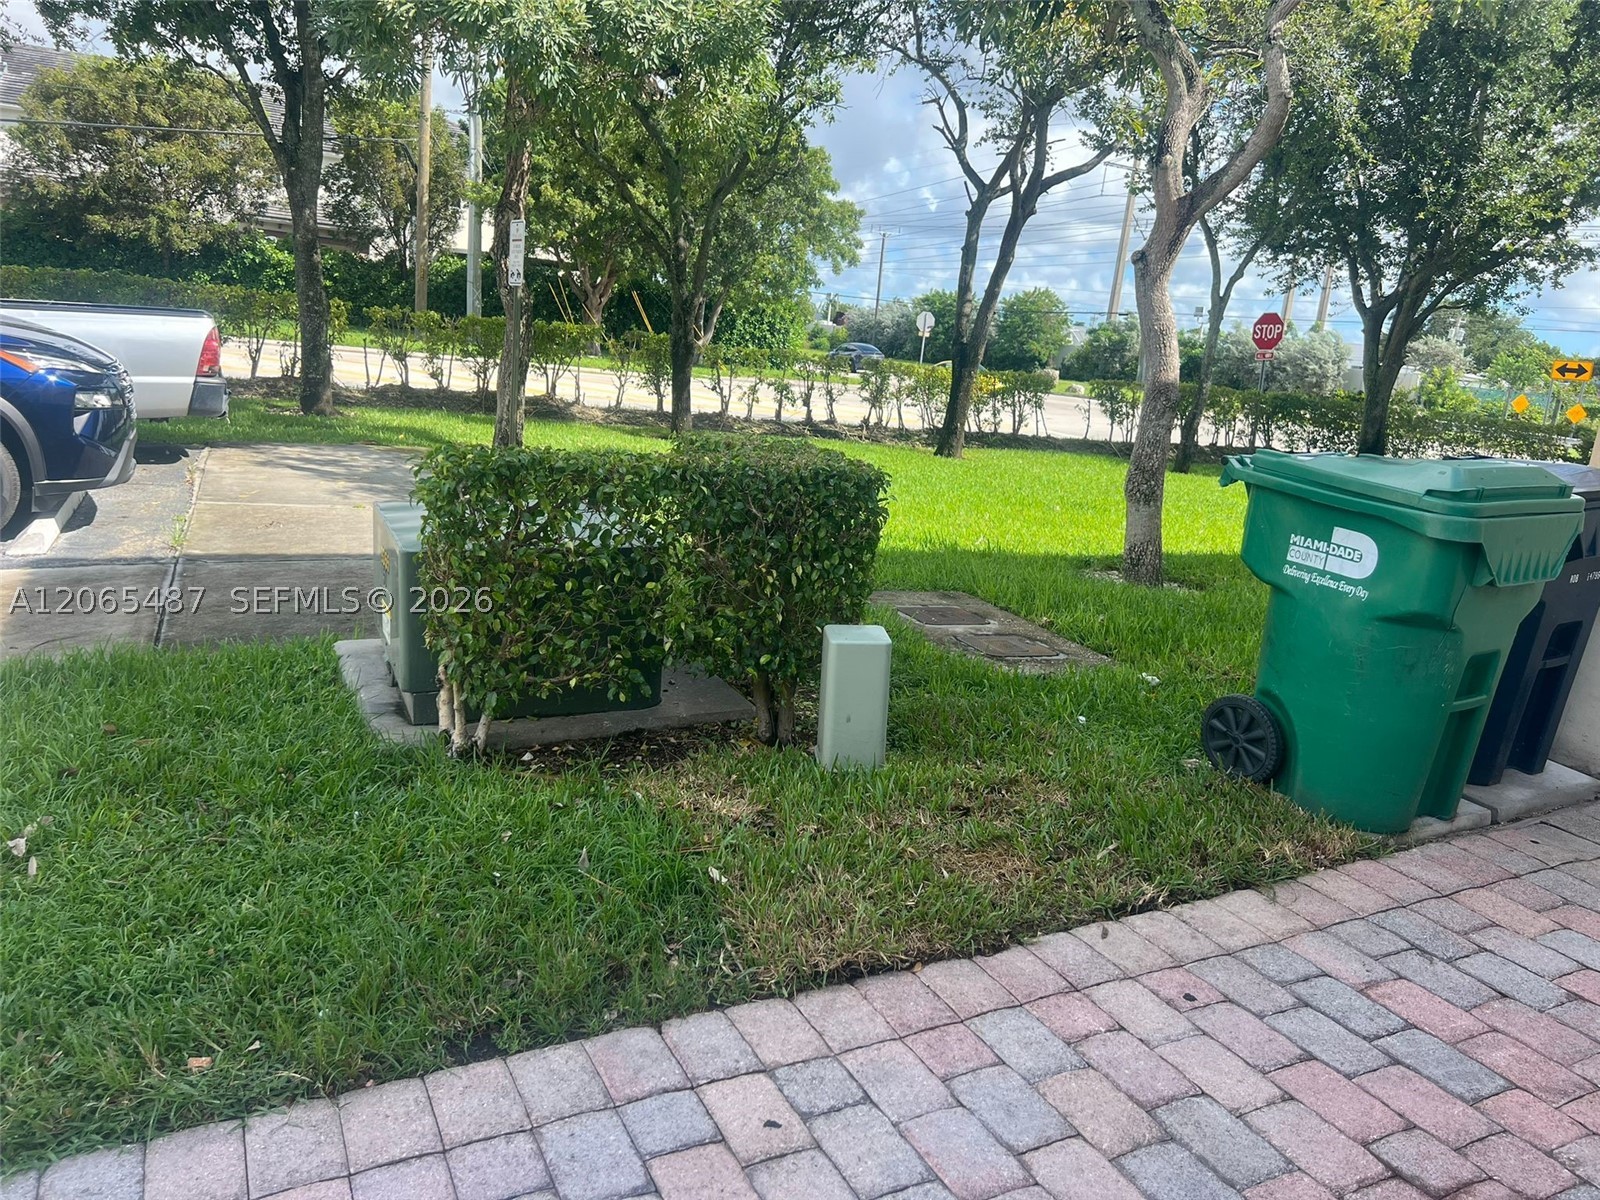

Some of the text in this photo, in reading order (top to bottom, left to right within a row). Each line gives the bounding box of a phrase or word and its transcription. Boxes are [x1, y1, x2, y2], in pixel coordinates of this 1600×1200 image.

[1254, 324, 1282, 339] STOP
[1288, 548, 1324, 565] COUNTY
[1283, 564, 1369, 601] Delivering Excellence Every Day
